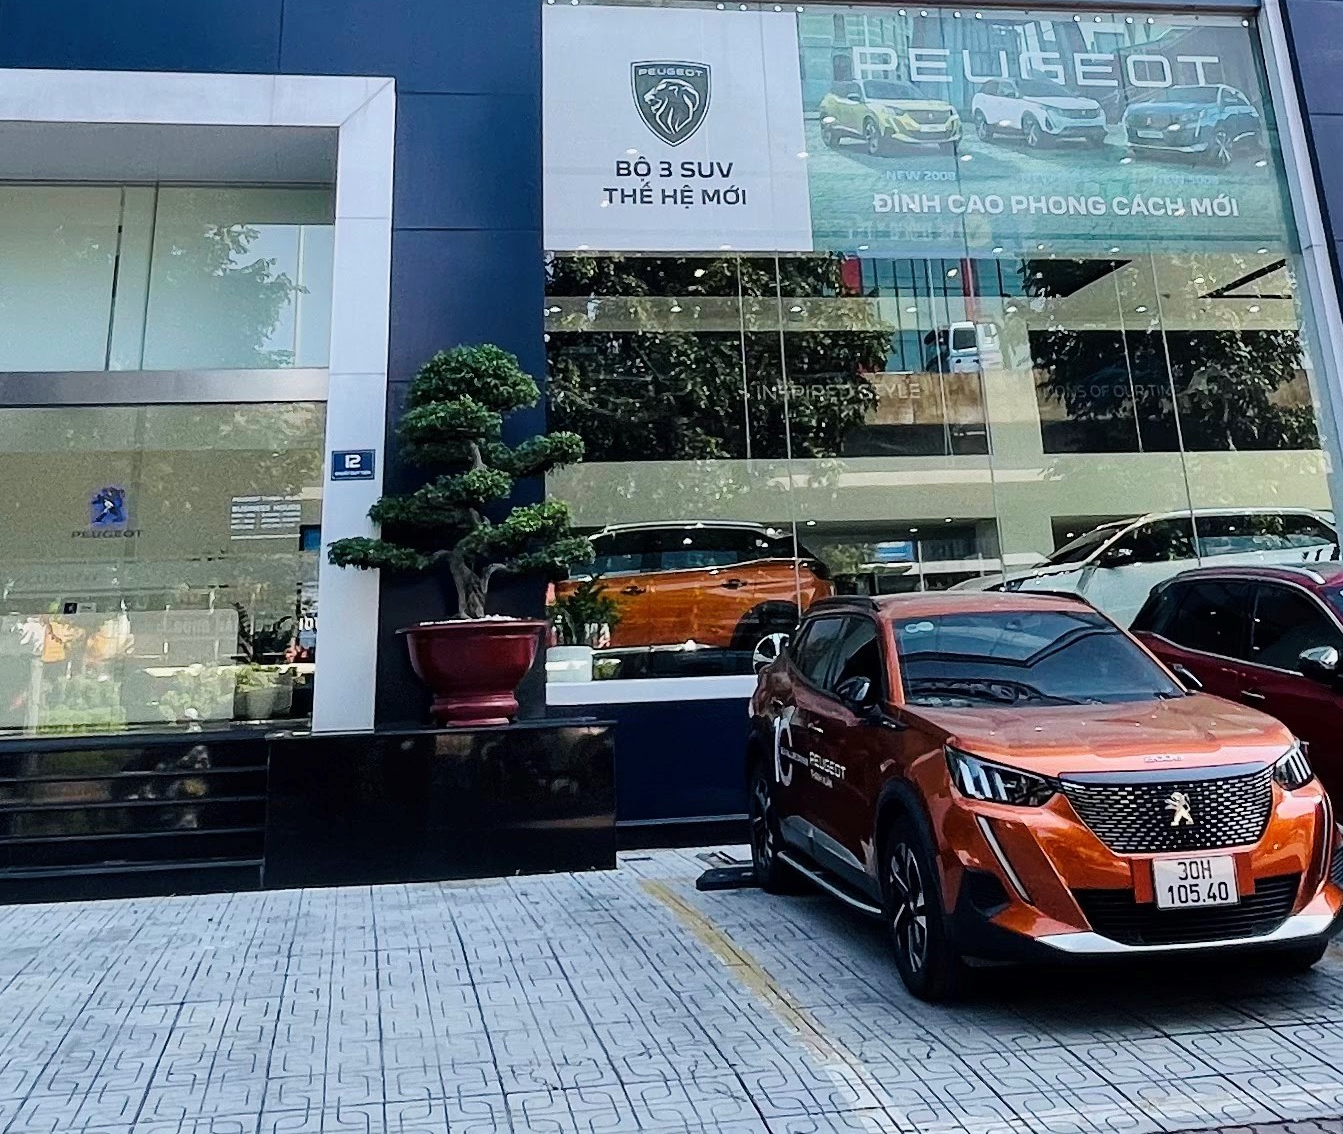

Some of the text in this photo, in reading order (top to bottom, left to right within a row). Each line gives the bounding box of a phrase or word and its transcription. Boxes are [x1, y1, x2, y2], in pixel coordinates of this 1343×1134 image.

[638, 68, 703, 77] PEUGEOT
[851, 45, 1220, 88] PEUGEOT
[616, 156, 733, 182] BỘ 3 SUV
[604, 181, 747, 209] THẾ HỆ MỚI
[873, 189, 1239, 217] ĐỈNH CAO PHONG CÁCH MỚI
[71, 530, 144, 539] PEUGEOT
[1177, 859, 1212, 881] 30H
[1168, 881, 1229, 904] 105.40
